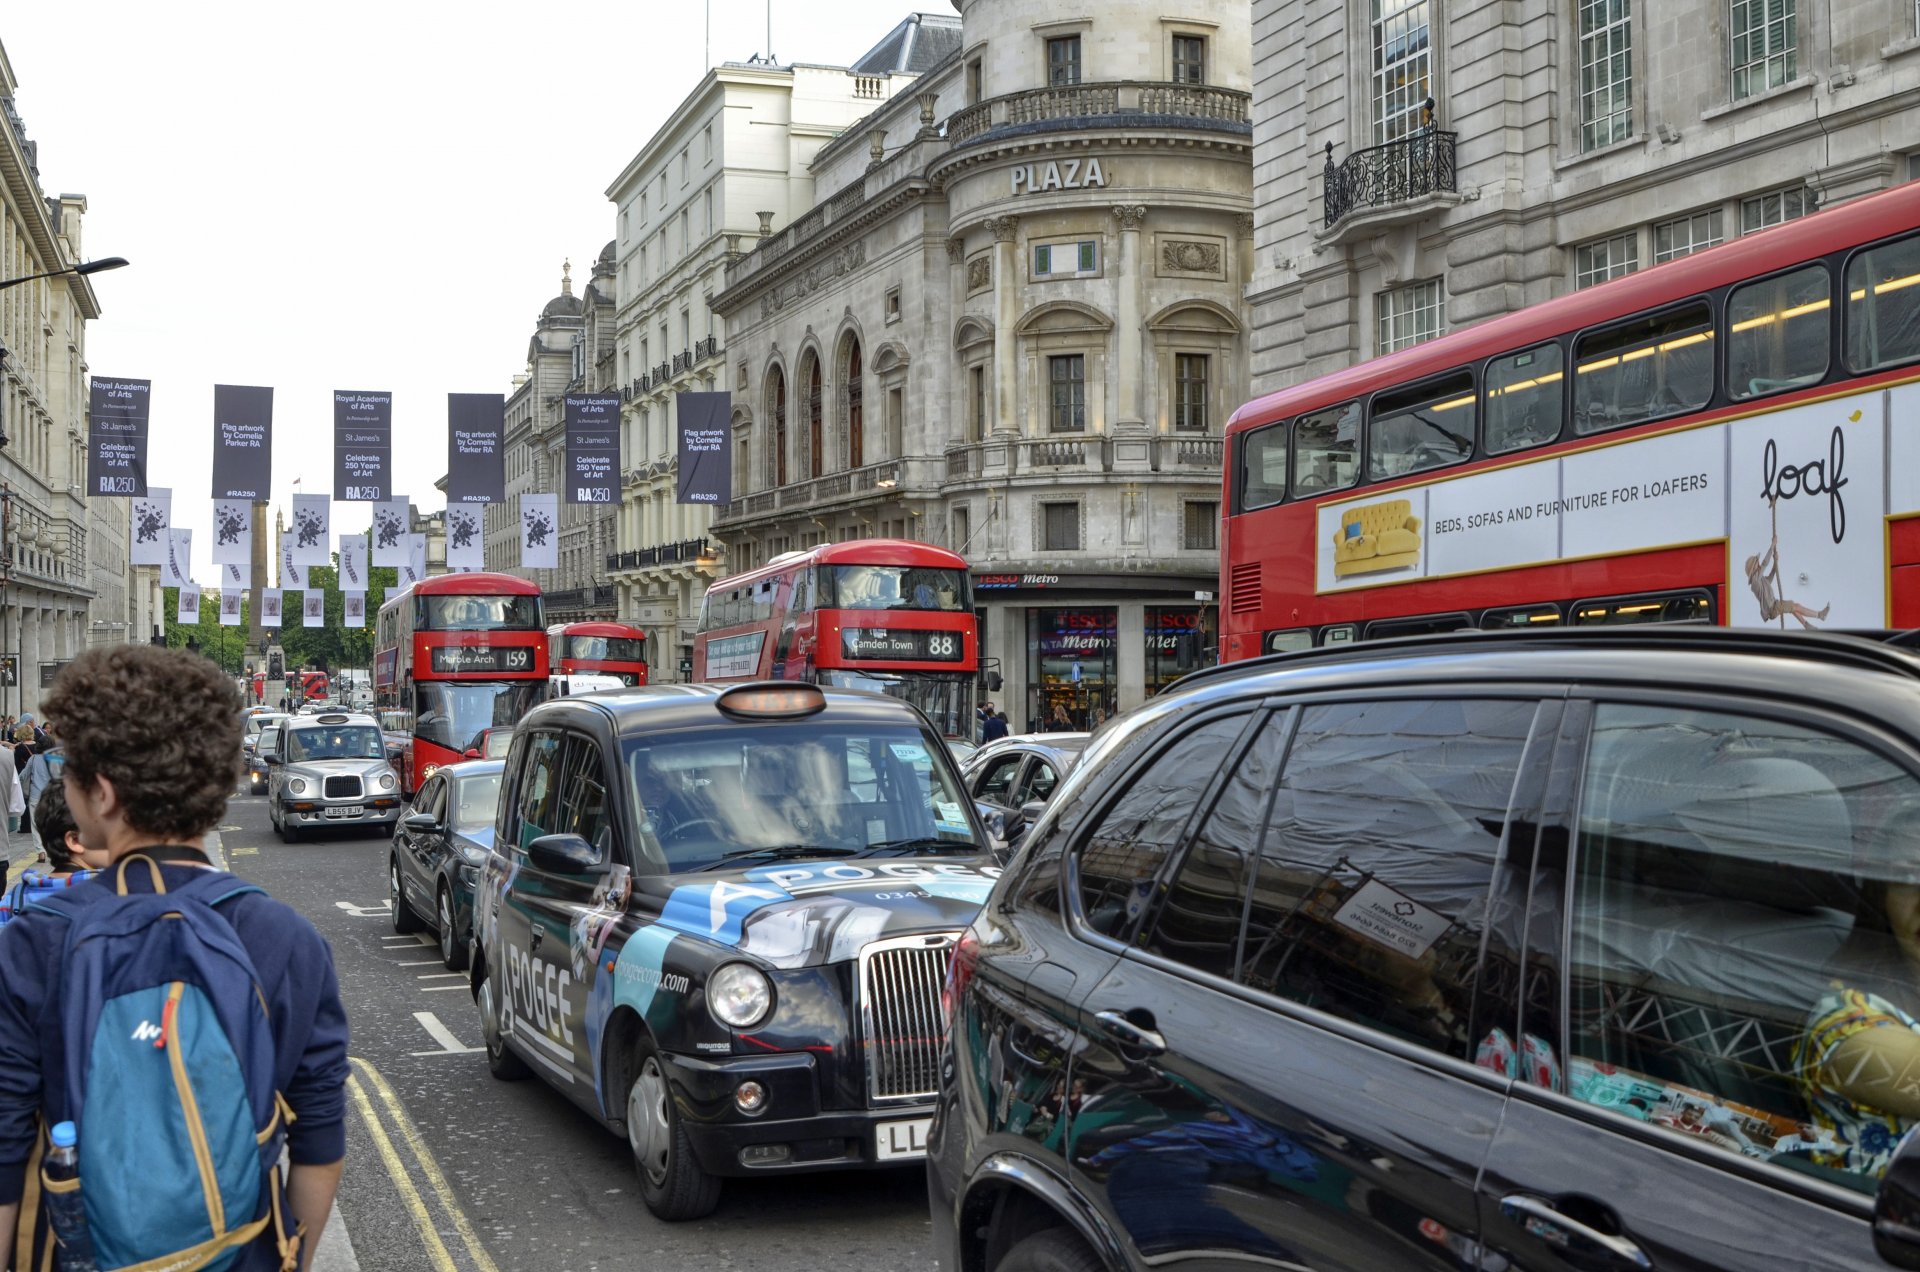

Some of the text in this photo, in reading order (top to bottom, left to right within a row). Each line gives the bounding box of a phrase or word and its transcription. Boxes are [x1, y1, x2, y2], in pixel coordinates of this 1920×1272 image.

[1010, 158, 1105, 195] PLAZA
[92, 380, 149, 392] Royal Academy
[108, 390, 116, 398] of
[336, 394, 390, 404] Royal Academy
[567, 398, 619, 406] Royal Academy
[351, 402, 359, 410] of
[101, 421, 137, 431] St James's
[221, 423, 237, 432] Flag
[223, 431, 263, 440] by Cornelia
[455, 431, 470, 439] Flag
[684, 429, 699, 437] Flag
[354, 434, 380, 442] James's
[576, 436, 610, 444] St James's
[100, 443, 136, 451] Celebrate
[345, 454, 380, 462] Celebrate
[576, 456, 610, 464] Celebrate
[117, 459, 129, 467] Art
[353, 469, 360, 477] of
[100, 476, 135, 493] RA250
[1761, 426, 1848, 544] loaf
[346, 486, 380, 500] RA250
[577, 488, 610, 502] RA250
[1435, 473, 1708, 534] BEDS, SOFAS AND FURNITURE FOR LOAFERS
[980, 575, 1018, 584] TESCO
[664, 609, 673, 617] 15
[851, 636, 953, 655] Camden Town 88
[1062, 635, 1111, 649] Metro
[1146, 635, 1178, 649] Met
[440, 651, 527, 666] Marble Arch 159
[875, 891, 932, 900] 0345
[501, 938, 574, 1046] APOGEE
